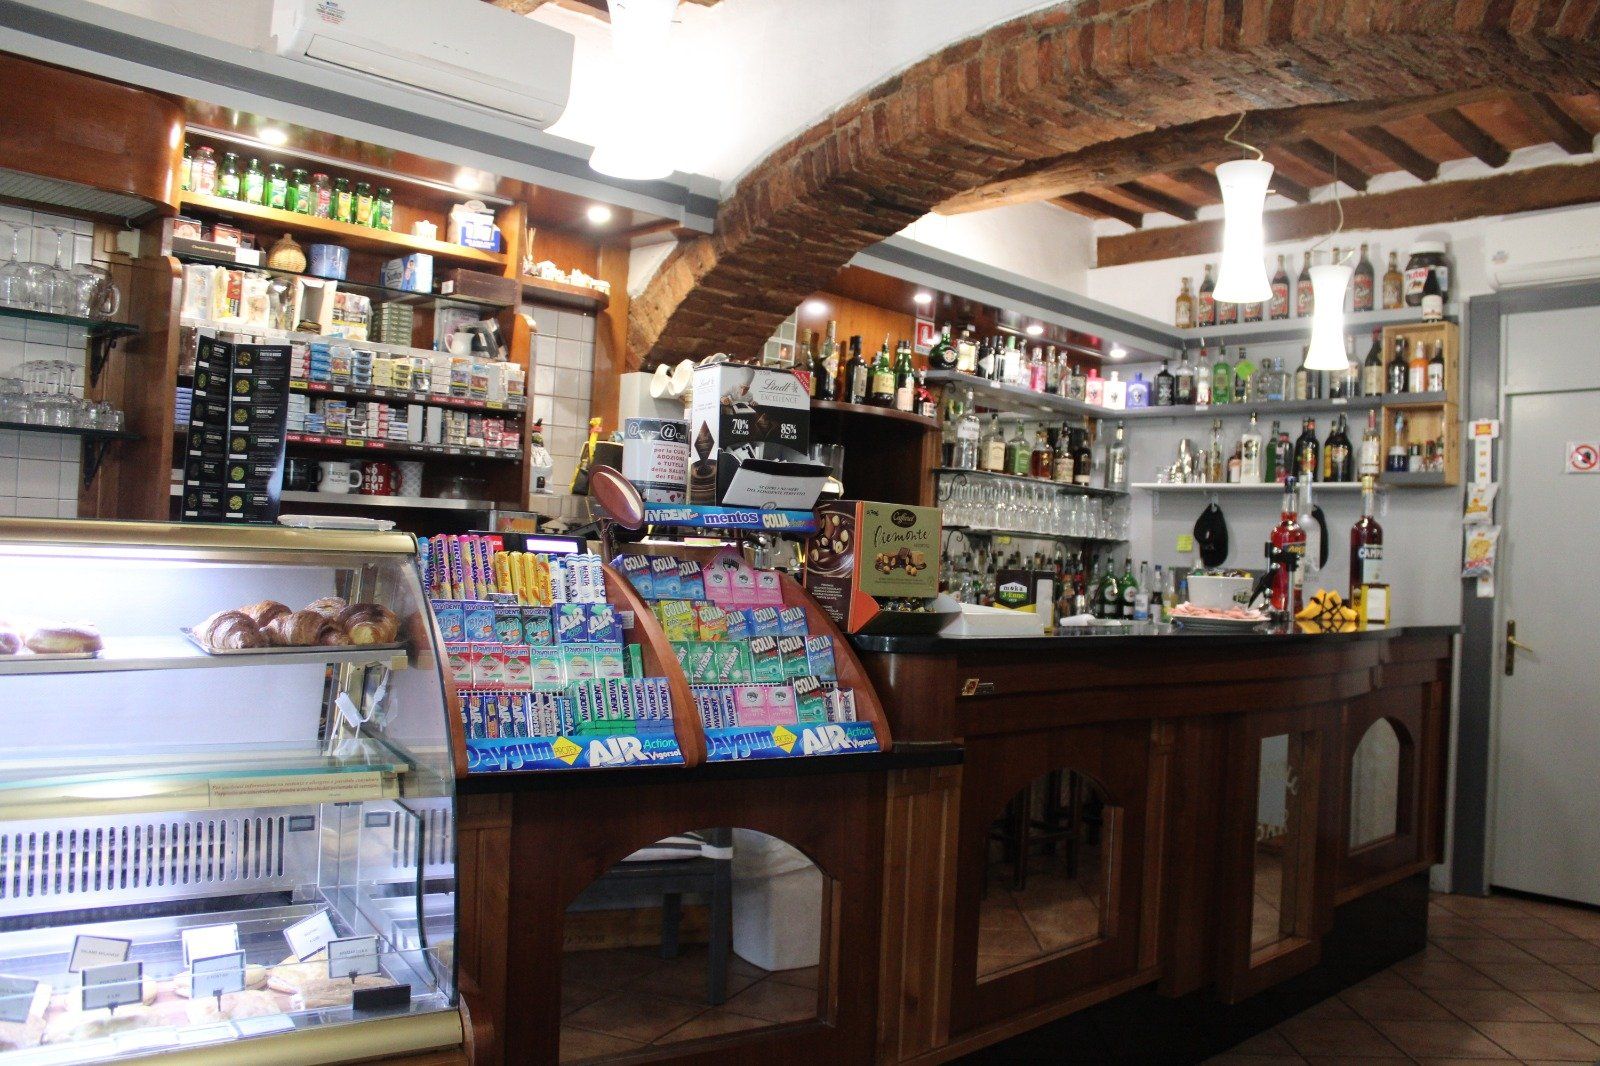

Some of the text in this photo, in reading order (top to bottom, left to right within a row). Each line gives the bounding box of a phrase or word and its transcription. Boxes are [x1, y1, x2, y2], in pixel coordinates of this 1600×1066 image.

[763, 378, 791, 390] Lindt
[732, 418, 749, 430] 70%
[704, 511, 758, 525] mentos
[762, 513, 790, 528] GOLIA
[874, 525, 928, 548] Piemonte
[437, 540, 446, 582] mentos
[624, 555, 650, 572] GOLIA
[652, 556, 678, 572] GOLIA
[663, 601, 688, 618] GOLIA
[699, 607, 724, 622] GOLIA
[754, 607, 778, 624] GOLIA
[780, 607, 805, 624] GOLIA
[560, 608, 586, 634] AIR
[588, 608, 616, 634] AIR
[446, 646, 469, 654] aygum
[472, 645, 502, 655] Daygum
[564, 646, 592, 655] Daygum
[594, 646, 621, 655] Daygum
[751, 636, 776, 654] GOLIA
[779, 636, 804, 654] GOLIA
[808, 636, 832, 652] GOLIA
[532, 648, 558, 658] Daygum
[796, 676, 820, 694] GOLIA
[803, 724, 852, 755] AIR
[846, 727, 873, 738] Action
[644, 738, 677, 749] Action
[852, 737, 877, 748] Vigorsol
[468, 741, 555, 770] Daygum
[590, 736, 645, 768] AIR
[649, 750, 682, 762] Vigorsol
